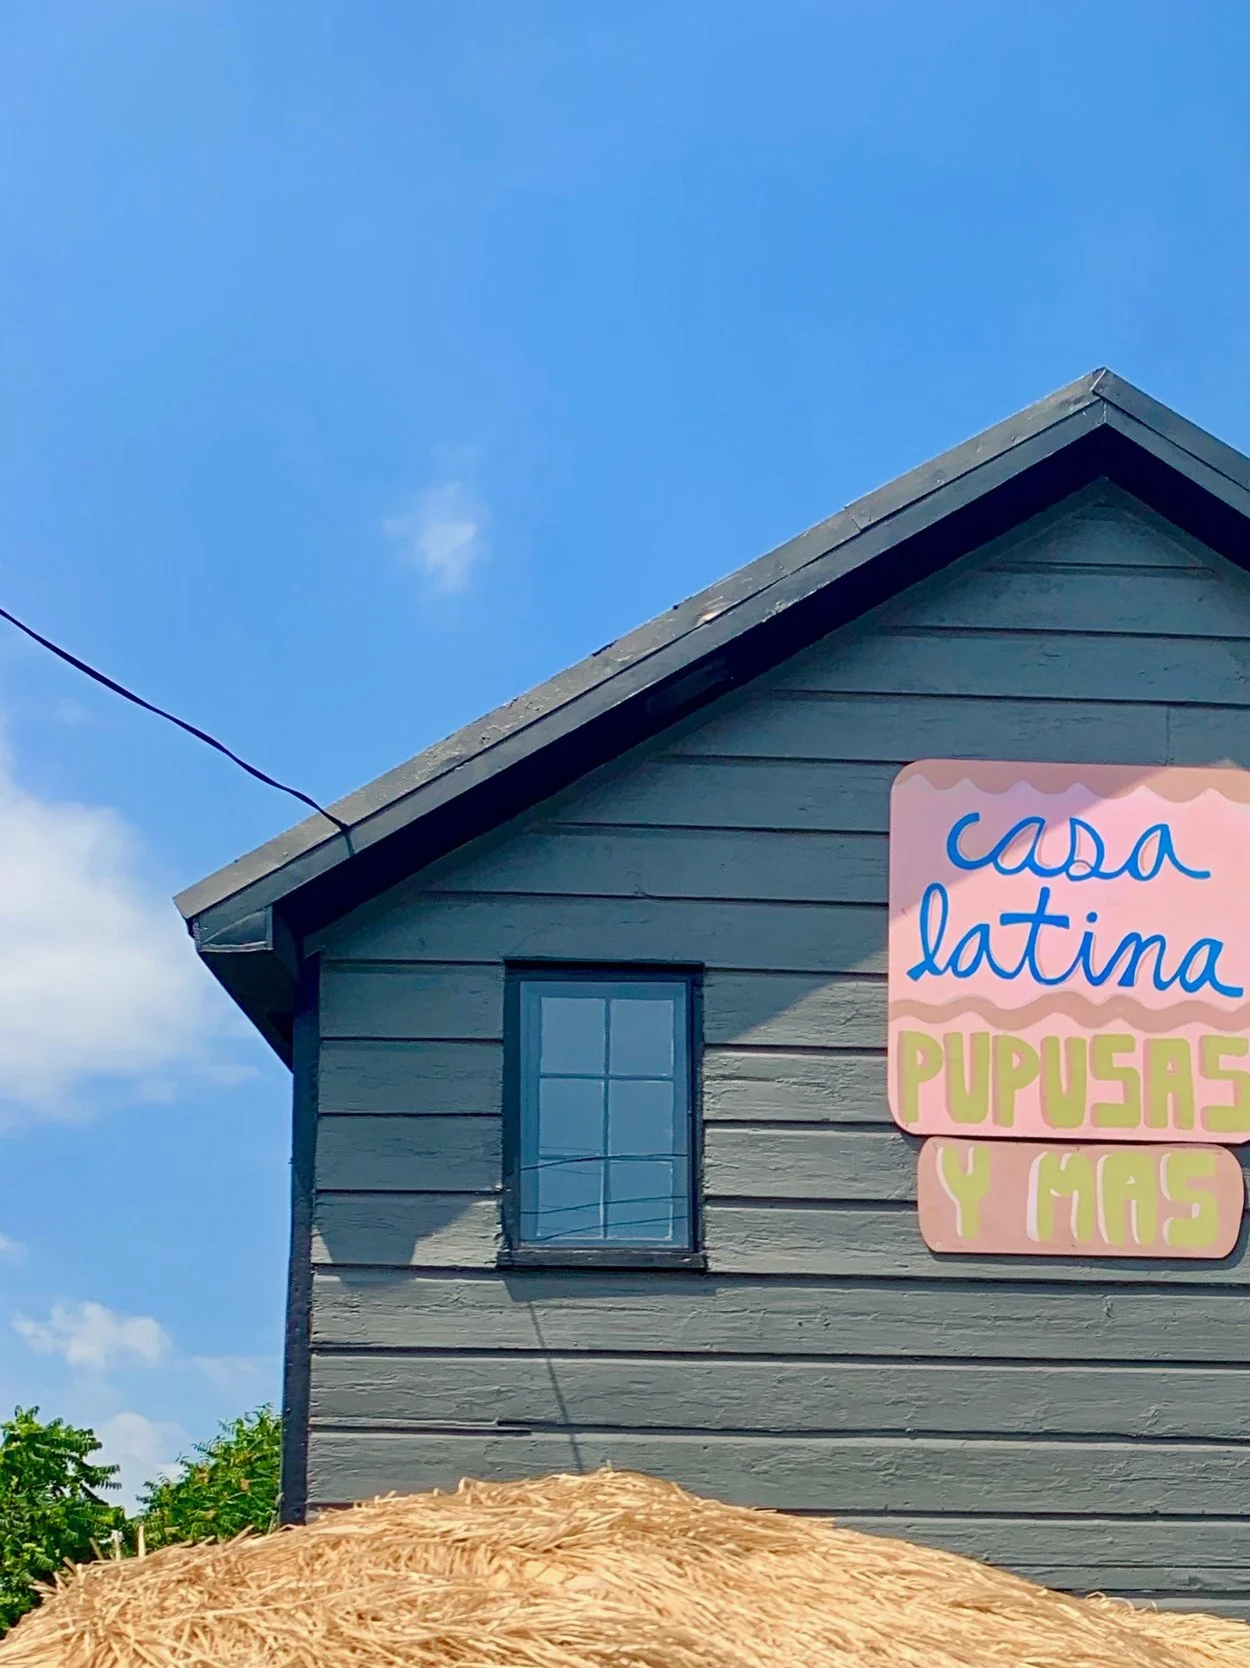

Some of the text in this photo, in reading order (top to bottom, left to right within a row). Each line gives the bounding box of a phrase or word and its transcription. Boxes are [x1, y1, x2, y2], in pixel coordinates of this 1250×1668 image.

[946, 812, 1211, 881] casa
[906, 882, 1243, 998] latina
[937, 1146, 1219, 1248] Y MAS
